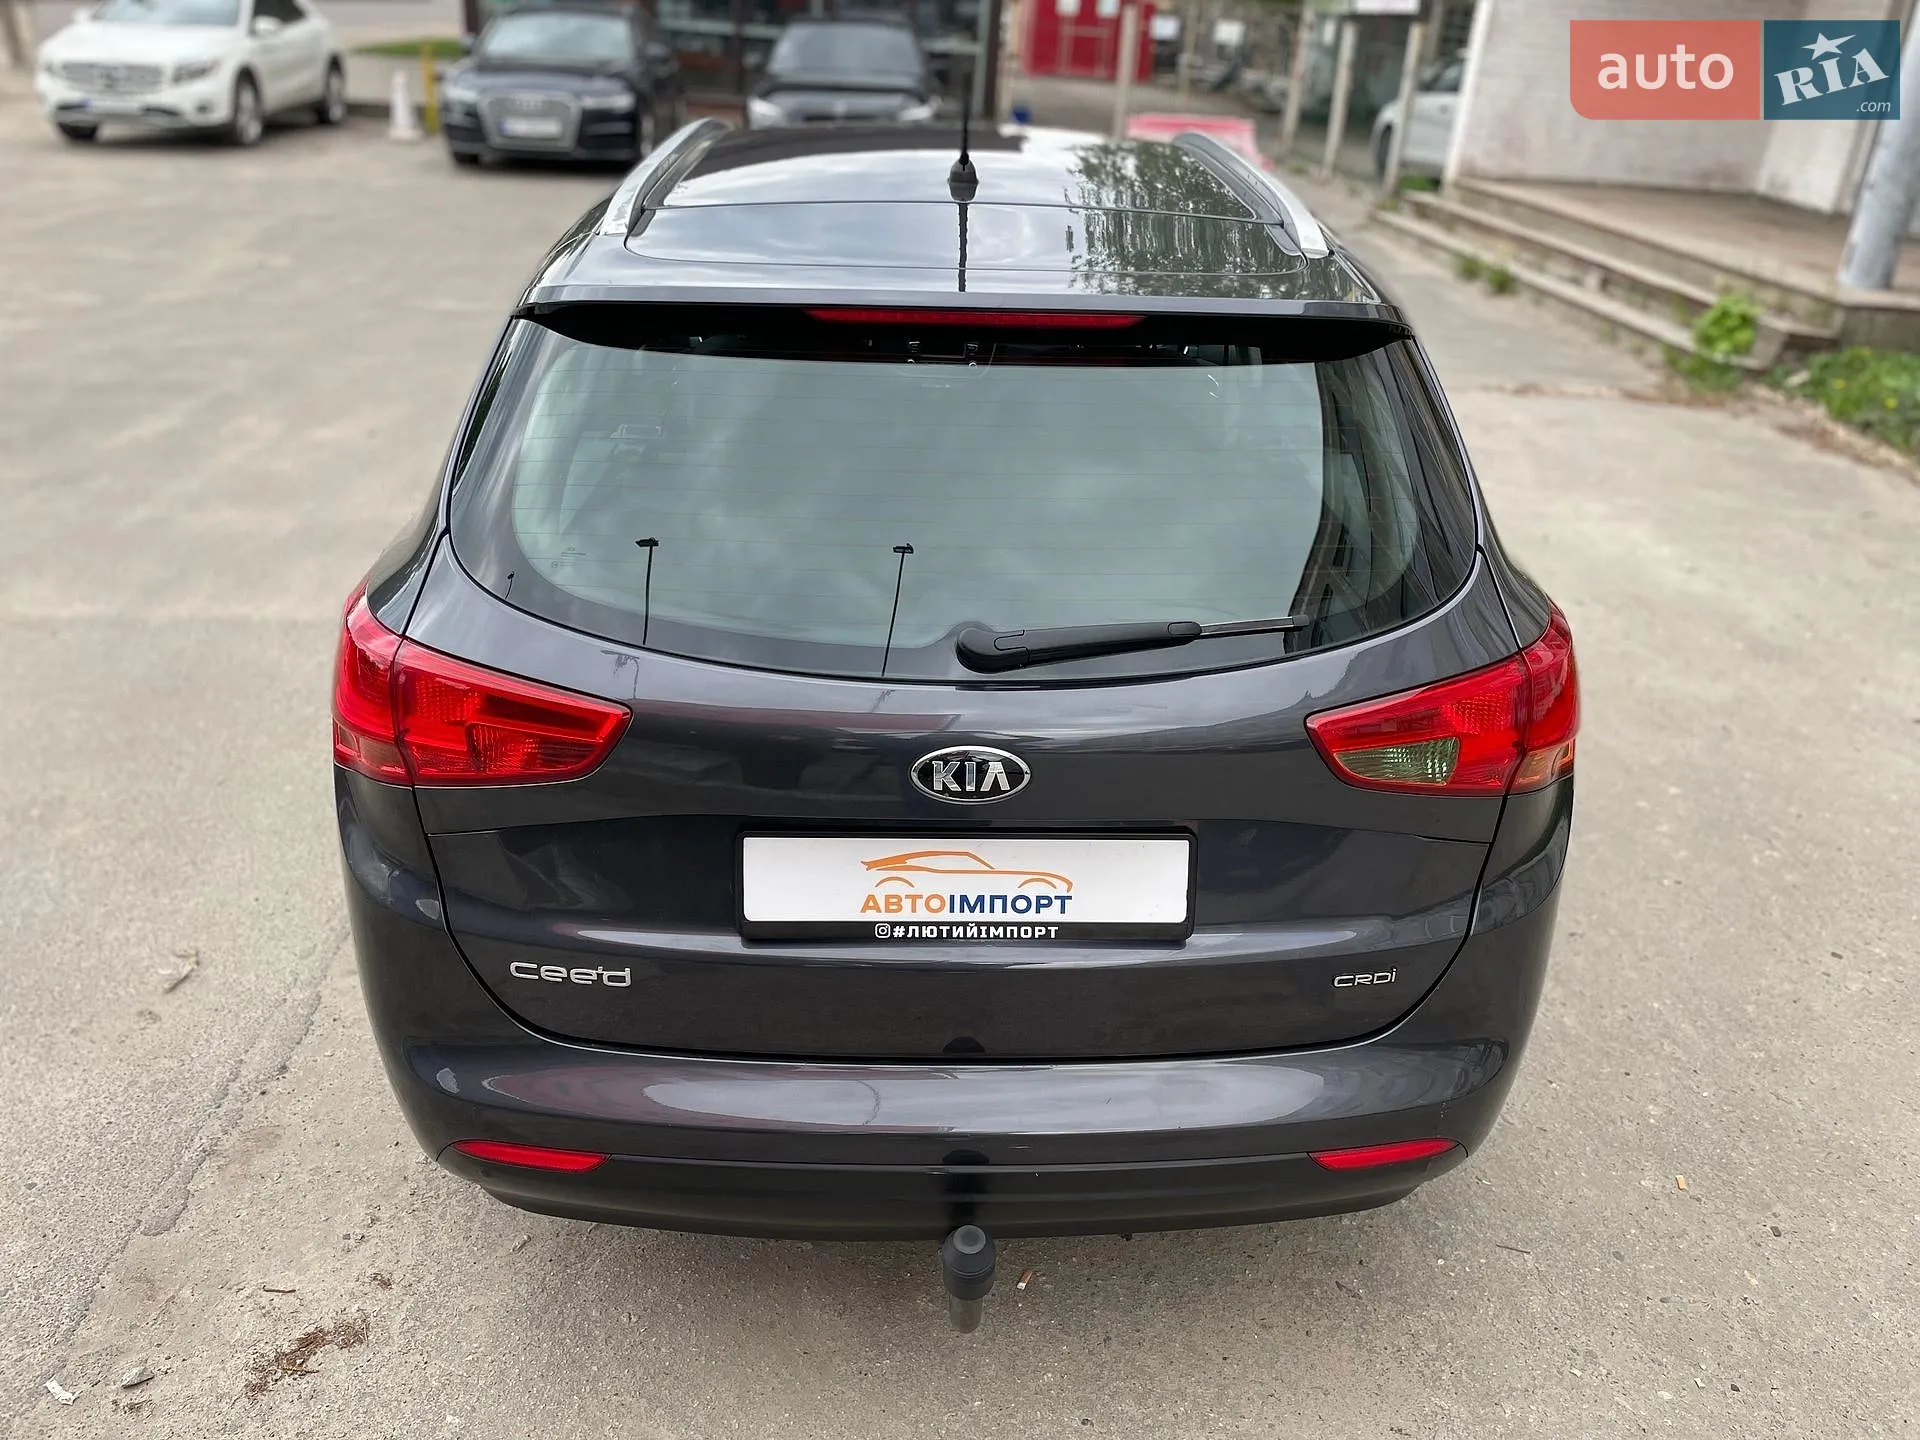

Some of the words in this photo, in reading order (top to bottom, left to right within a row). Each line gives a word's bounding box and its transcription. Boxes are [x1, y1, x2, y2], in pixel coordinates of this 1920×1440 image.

[931, 760, 1011, 792] KIA
[860, 893, 1073, 915] АВТОІМПОРТ
[1333, 968, 1397, 988] CRDi
